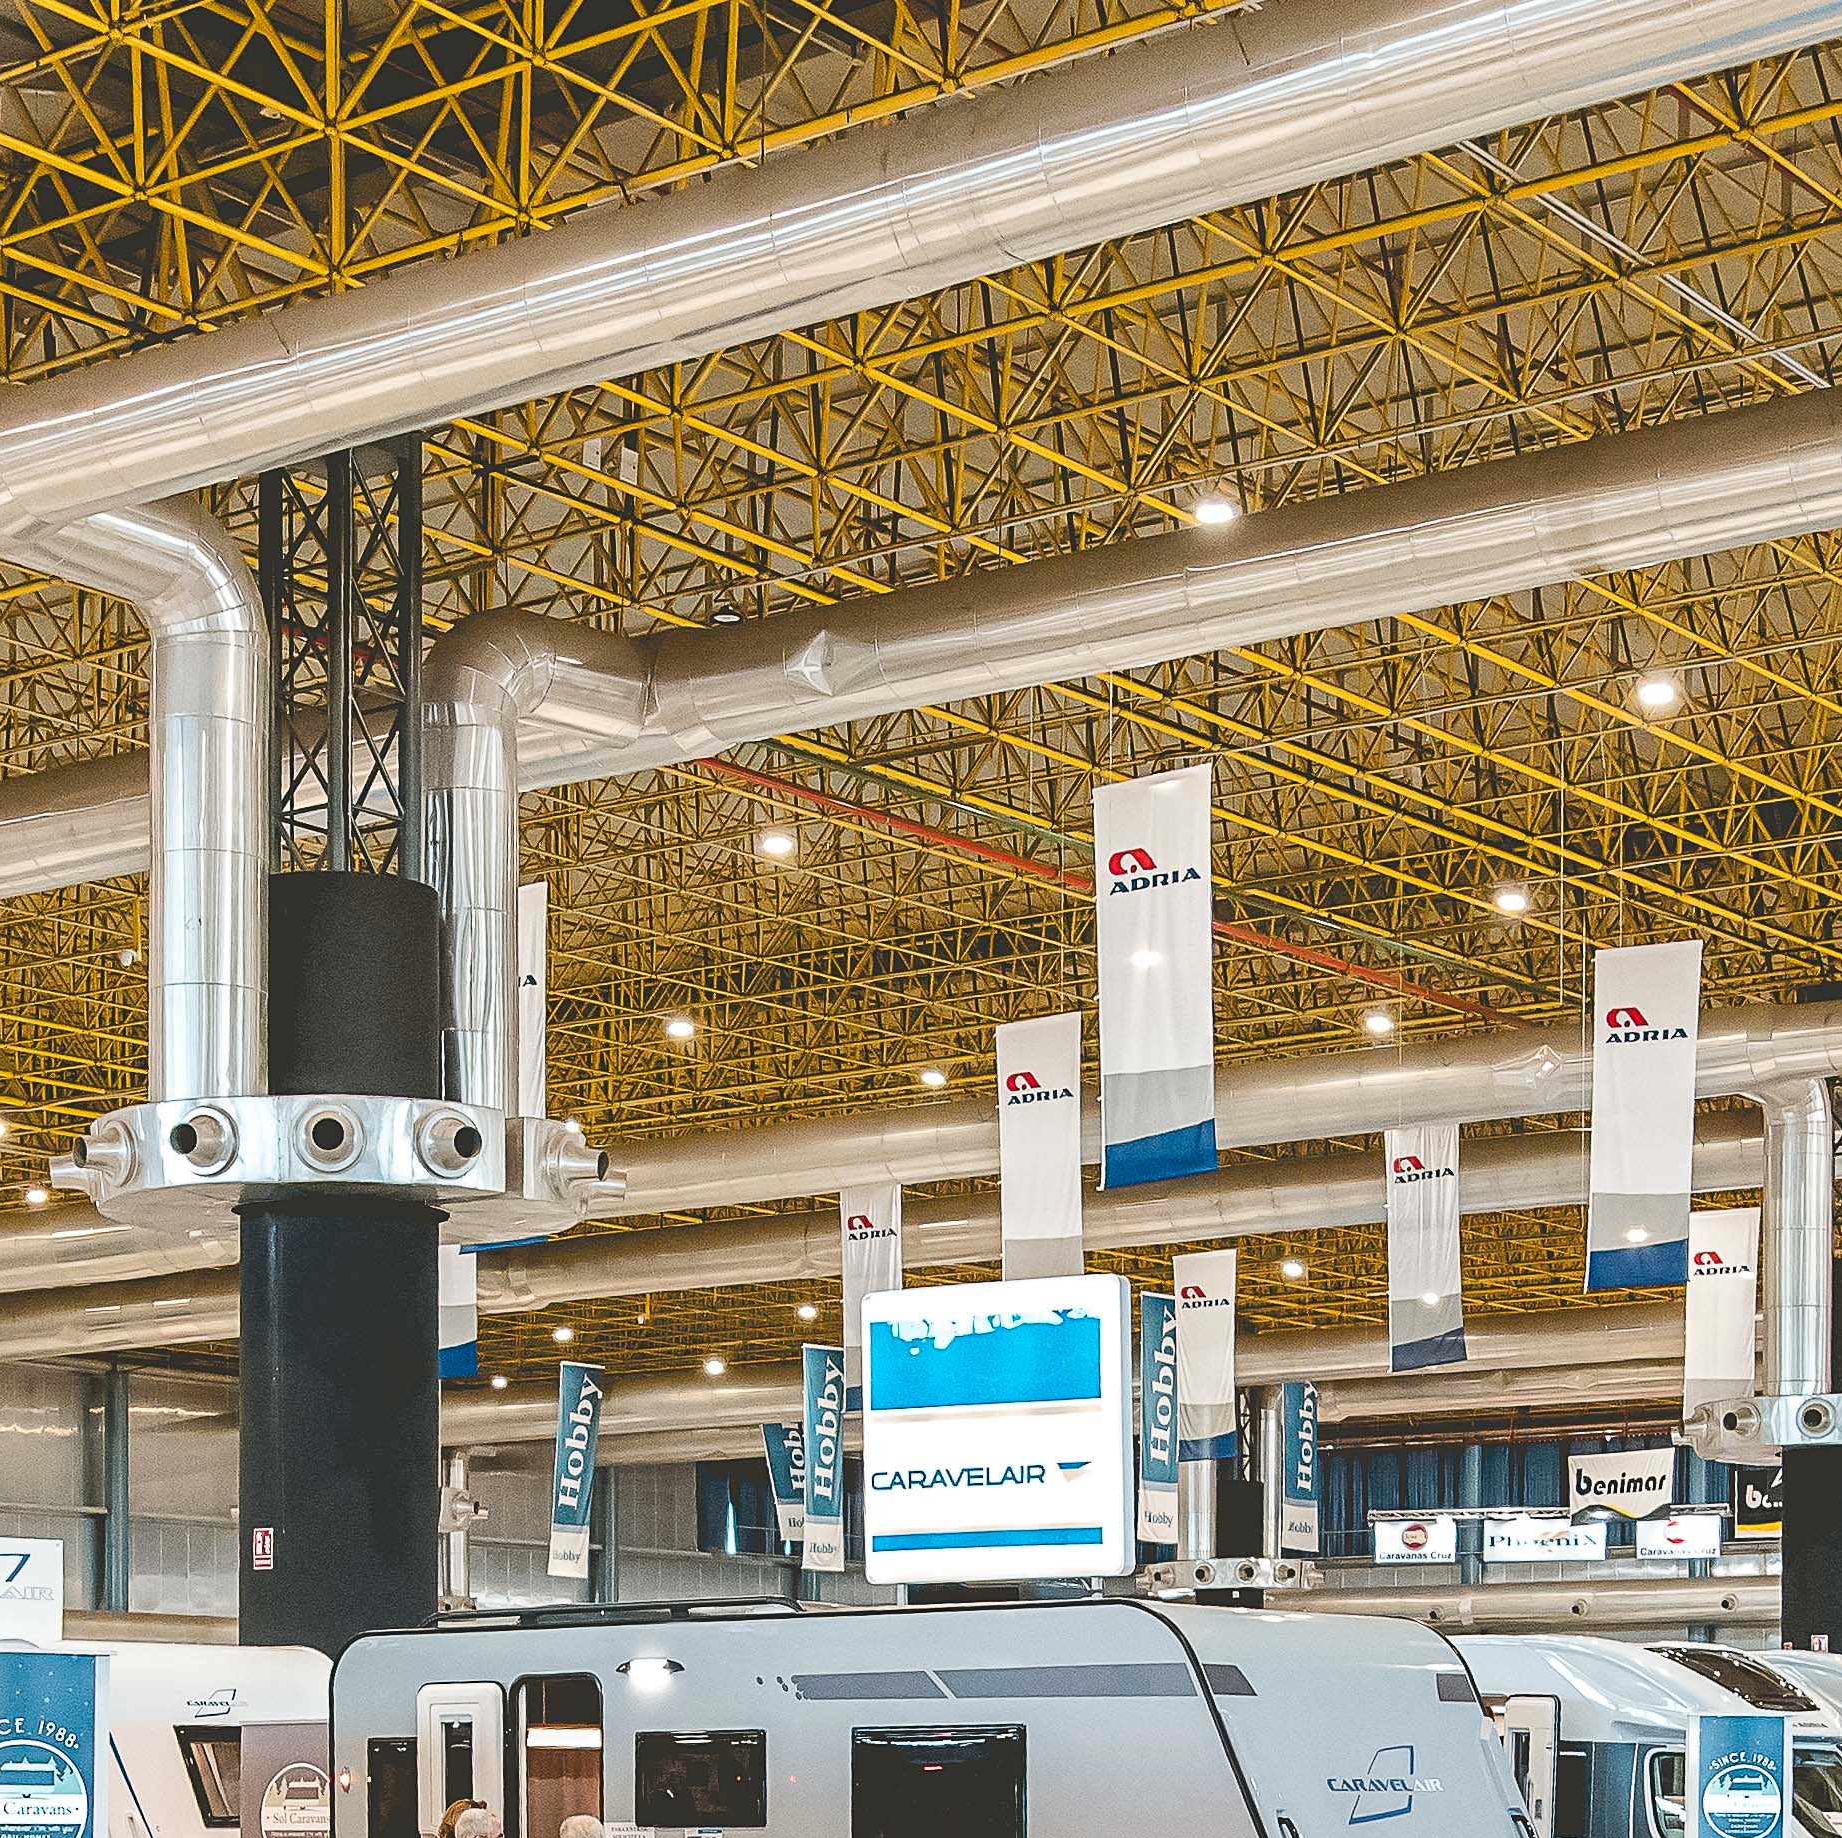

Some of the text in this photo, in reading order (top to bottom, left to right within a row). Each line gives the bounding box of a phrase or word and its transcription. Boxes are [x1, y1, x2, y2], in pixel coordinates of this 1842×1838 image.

[1109, 866, 1202, 896] ADRIA
[1606, 1025, 1688, 1045] ADRIA
[1007, 1085, 1074, 1106] ADRIA
[1394, 1165, 1455, 1185] ADRIA
[847, 1225, 898, 1241] ADRIA
[1693, 1261, 1751, 1276] ADRIA
[1181, 1298, 1230, 1309] ADRIA
[813, 1356, 846, 1501] Hobby
[558, 1373, 604, 1510] Hobby
[783, 1422, 804, 1491] Hob
[871, 1464, 1046, 1491] CARAVELAIR
[1575, 1468, 1667, 1497] benimar
[38, 1718, 78, 1750] 1988
[1711, 1752, 1747, 1770] SINCE
[1327, 1778, 1444, 1792] CARAVELAIR
[3, 1802, 73, 1816] Caravans
